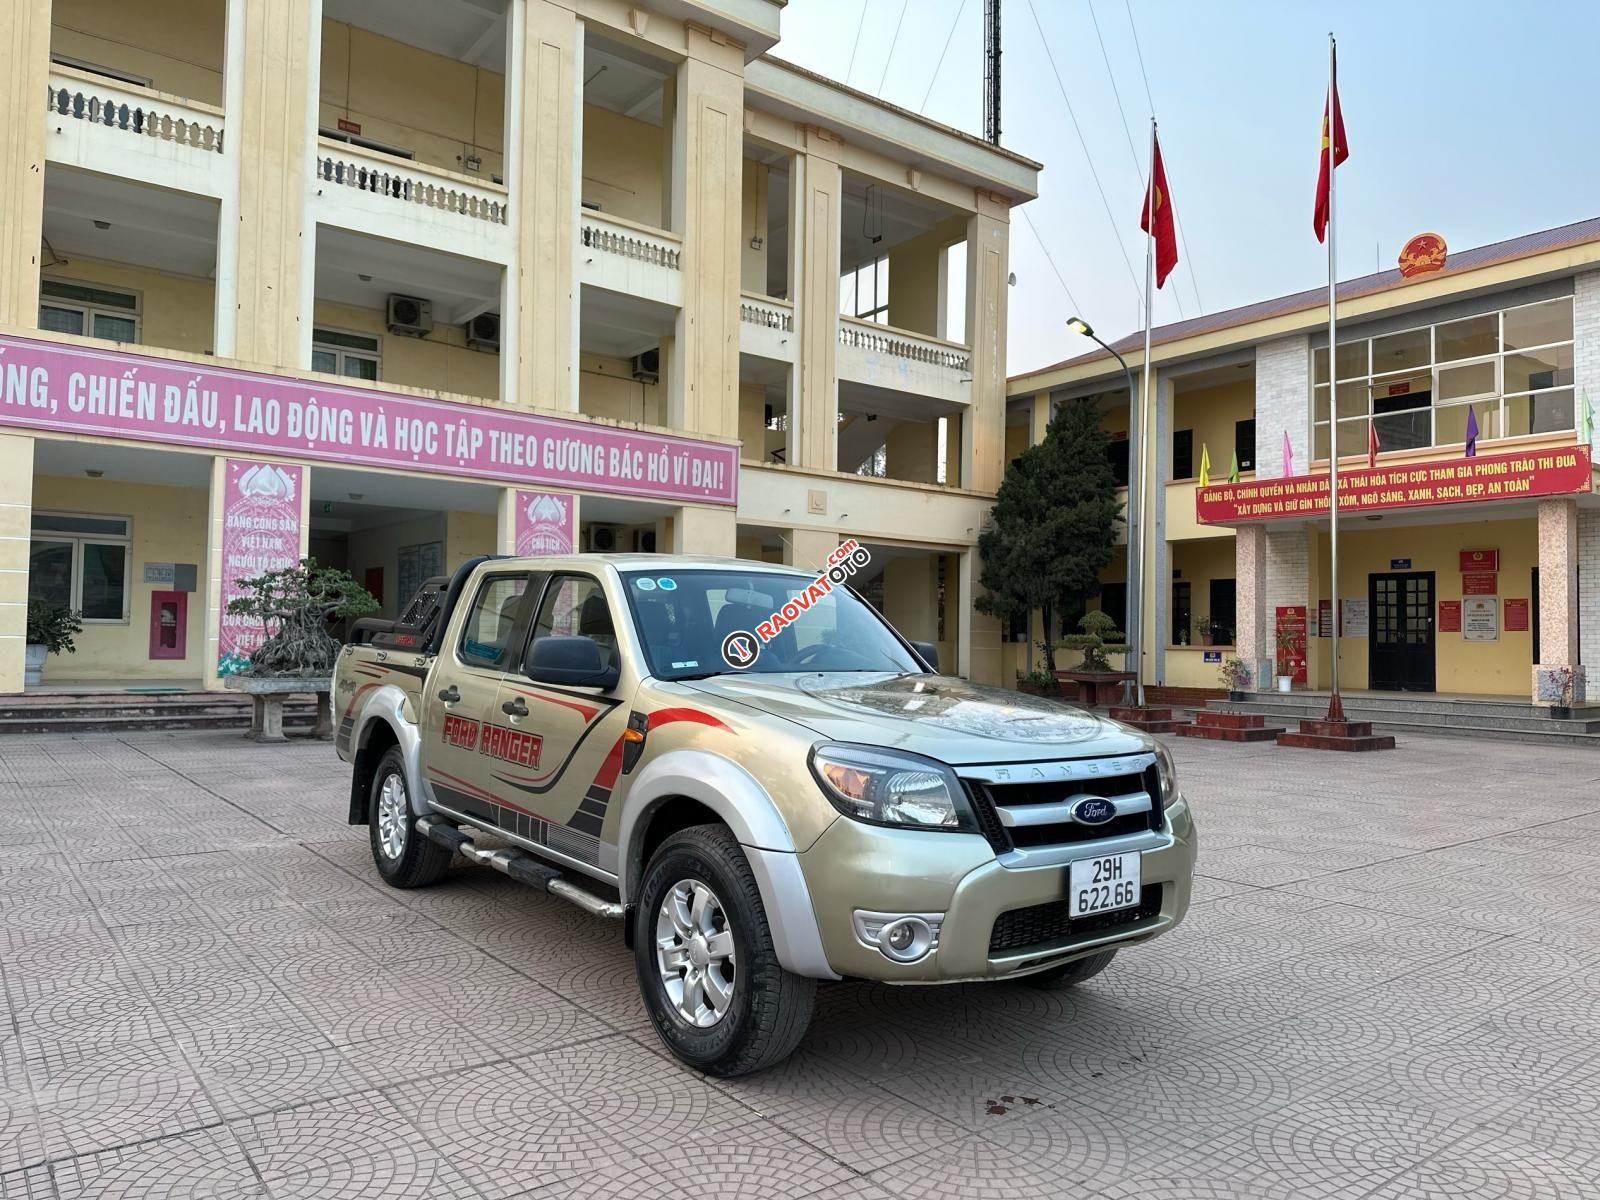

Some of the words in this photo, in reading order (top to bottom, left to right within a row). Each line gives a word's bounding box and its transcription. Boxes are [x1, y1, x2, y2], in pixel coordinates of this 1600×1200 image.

[0, 348, 58, 414] NG,
[68, 368, 156, 421] CHIẾN
[164, 375, 226, 434] ĐẤU,
[234, 395, 280, 436] LAO
[287, 397, 353, 448] ĐỘNG
[360, 407, 388, 449] VÀ
[395, 417, 438, 461] HỌC
[444, 419, 483, 465] TẬP
[489, 430, 538, 467] THEO
[543, 435, 604, 476] GƯƠNG
[609, 443, 643, 481] BÁC
[648, 445, 669, 485] HỒ
[673, 450, 688, 485] VĨ
[692, 458, 724, 494] ĐẠI!
[1236, 486, 1258, 500] CHÍNH
[1284, 482, 1295, 495] VÀ
[1296, 479, 1318, 494] NHÂN
[1337, 476, 1348, 490] XÃ
[1350, 474, 1368, 487] THÁI
[1389, 471, 1408, 485] TÍCH
[1410, 469, 1428, 485] CỰC
[1430, 467, 1455, 481] THAM
[1457, 465, 1473, 478] GIA
[1475, 461, 1507, 476] PHONG
[1510, 457, 1535, 473] TRÀO
[1537, 456, 1554, 470] THI
[1556, 454, 1577, 468] ĐUA
[1252, 502, 1273, 516] DỰNG
[1273, 499, 1284, 512] VÀ
[1285, 497, 1298, 511] GIỮ
[1299, 496, 1313, 510] GÌN
[1314, 495, 1331, 509] THÔ
[1361, 490, 1379, 505] NGÕ
[1380, 489, 1406, 504] SÁNG,
[1408, 488, 1434, 502] XANH,
[1436, 485, 1463, 500] SẠCH,
[1465, 484, 1486, 498] ĐẸP,
[1488, 481, 1502, 494] AN
[442, 713, 480, 751] FORD
[480, 722, 544, 770] RANGER
[994, 757, 1143, 780] RANGER
[1084, 802, 1108, 818] Ford
[1092, 857, 1122, 884] 29H
[1078, 881, 1134, 912] 622.66
